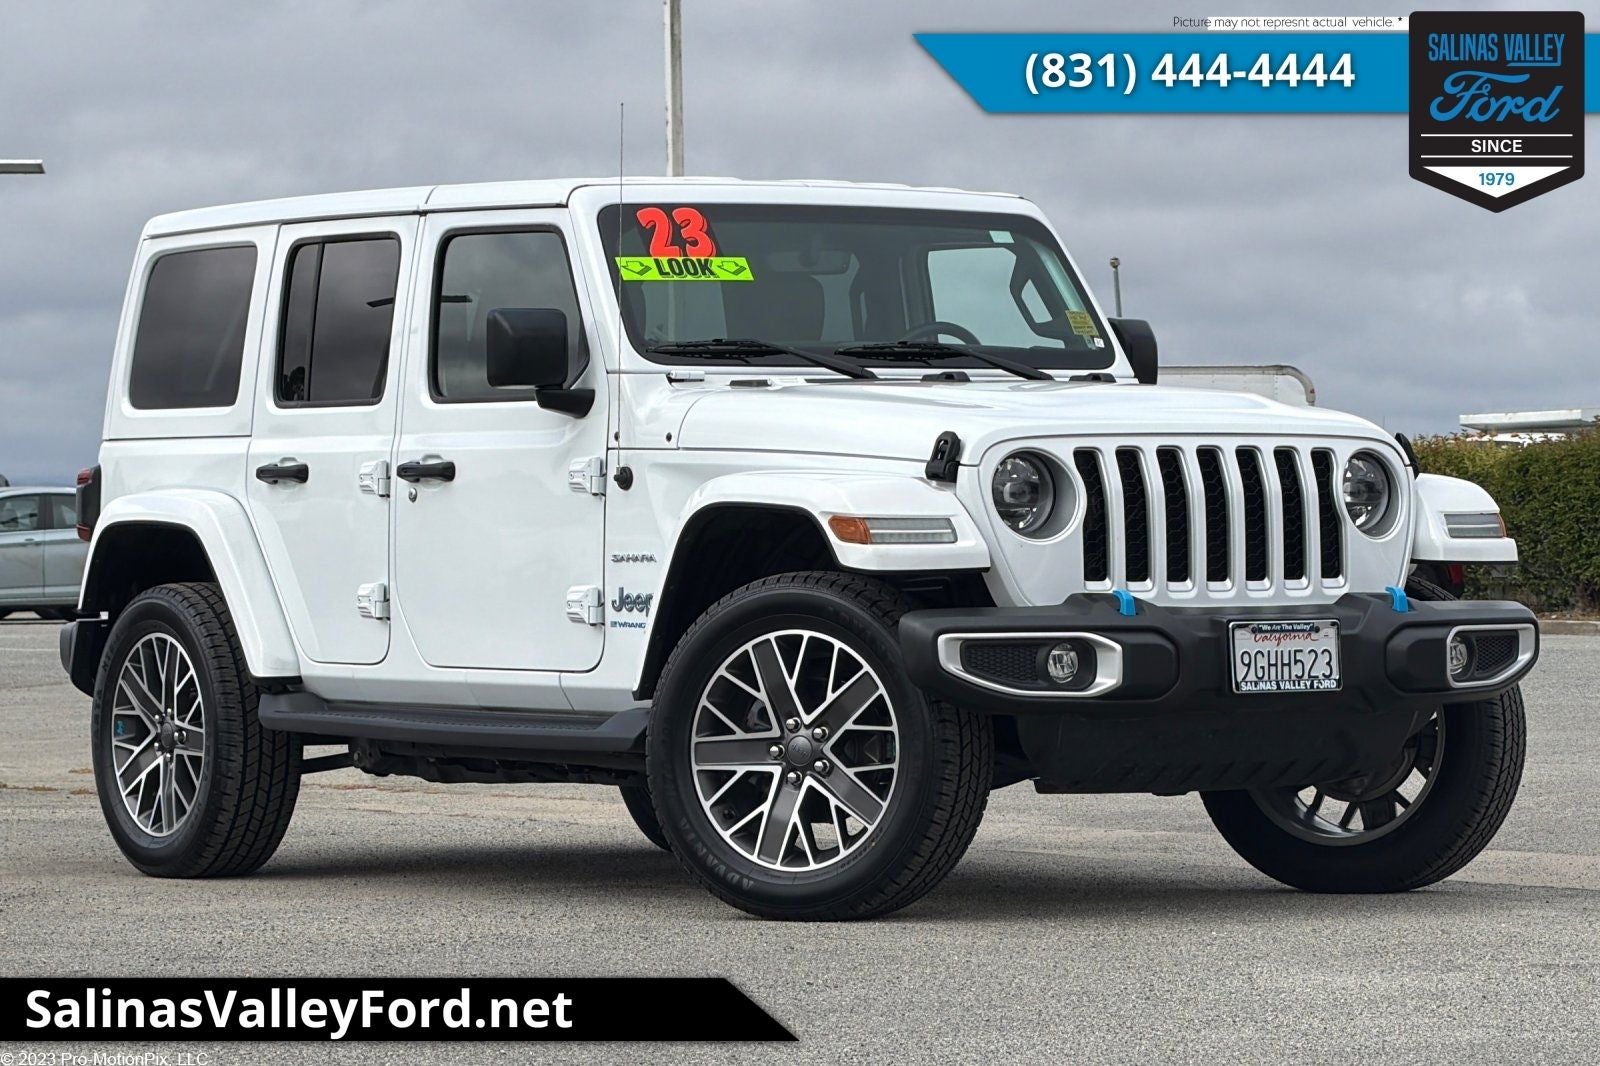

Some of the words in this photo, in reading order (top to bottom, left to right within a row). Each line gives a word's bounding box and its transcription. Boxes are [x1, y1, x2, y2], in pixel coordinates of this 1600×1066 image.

[636, 207, 717, 257] 23
[653, 257, 720, 279] LOOK
[611, 553, 657, 563] SAHARA
[611, 587, 654, 618] Jeep
[1253, 632, 1319, 647] California
[1240, 648, 1334, 681] 9GHH523
[1241, 680, 1278, 691] SALINAS
[1279, 680, 1311, 690] VALLEY
[1313, 679, 1337, 689] FORD
